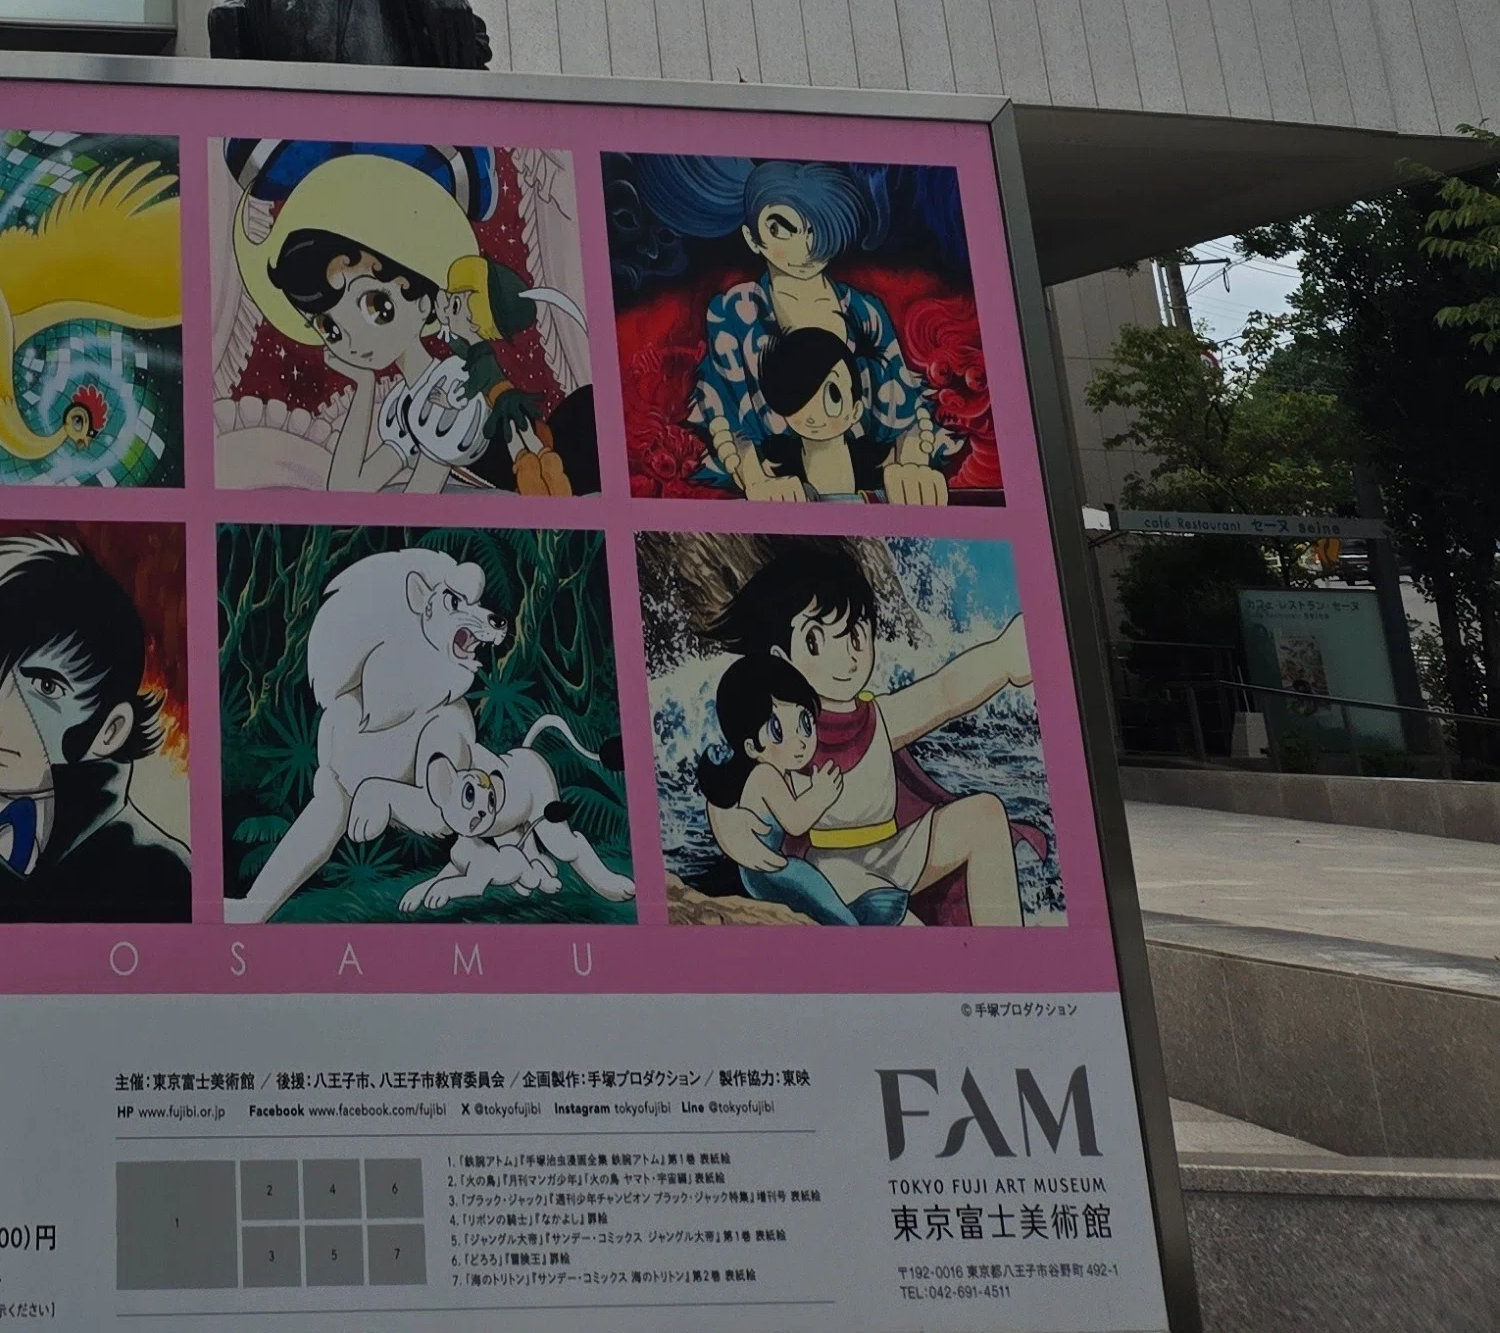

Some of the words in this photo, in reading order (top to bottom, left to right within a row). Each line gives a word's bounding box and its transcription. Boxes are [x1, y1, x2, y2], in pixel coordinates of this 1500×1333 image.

[1178, 519, 1241, 532] Restaurant
[1252, 521, 1289, 532] セーヌ
[109, 941, 593, 976] OSAMU
[116, 1105, 134, 1119] HP
[249, 1104, 305, 1118] Facebook
[554, 1102, 610, 1117] Instagram
[874, 1064, 1103, 1161] FAM
[888, 1179, 944, 1195] TOKYO
[952, 1178, 988, 1194] FUJI
[995, 1177, 1026, 1194] ART
[1033, 1177, 1106, 1194] MUSEUM
[890, 1202, 1112, 1242] 東京富士美術館
